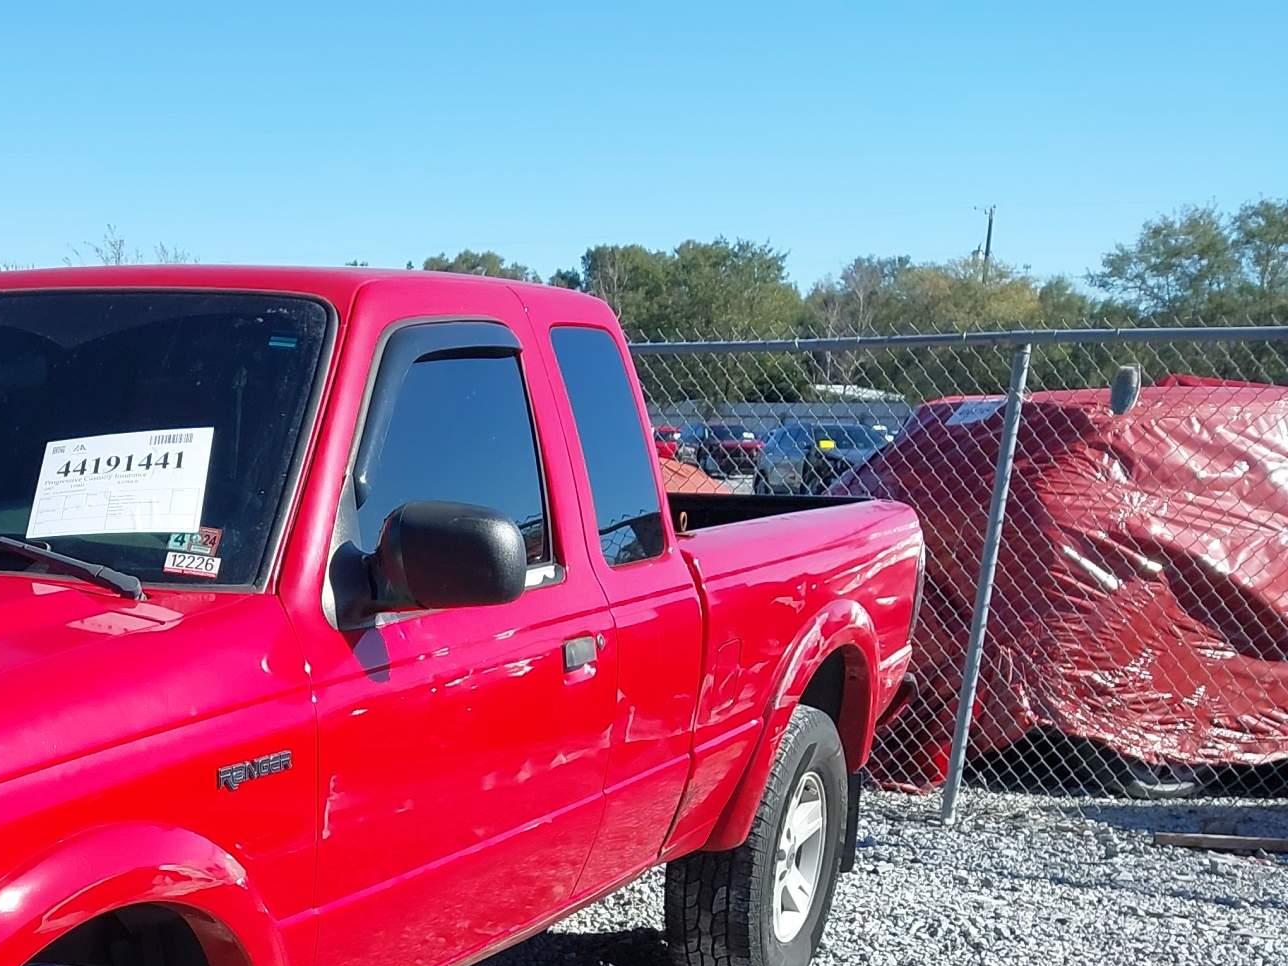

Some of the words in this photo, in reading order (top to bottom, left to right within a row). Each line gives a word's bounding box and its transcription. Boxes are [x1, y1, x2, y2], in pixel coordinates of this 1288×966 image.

[57, 451, 184, 477] 44191441
[203, 534, 217, 547] 24
[171, 554, 215, 572] 12226
[216, 750, 292, 792] RANGER
